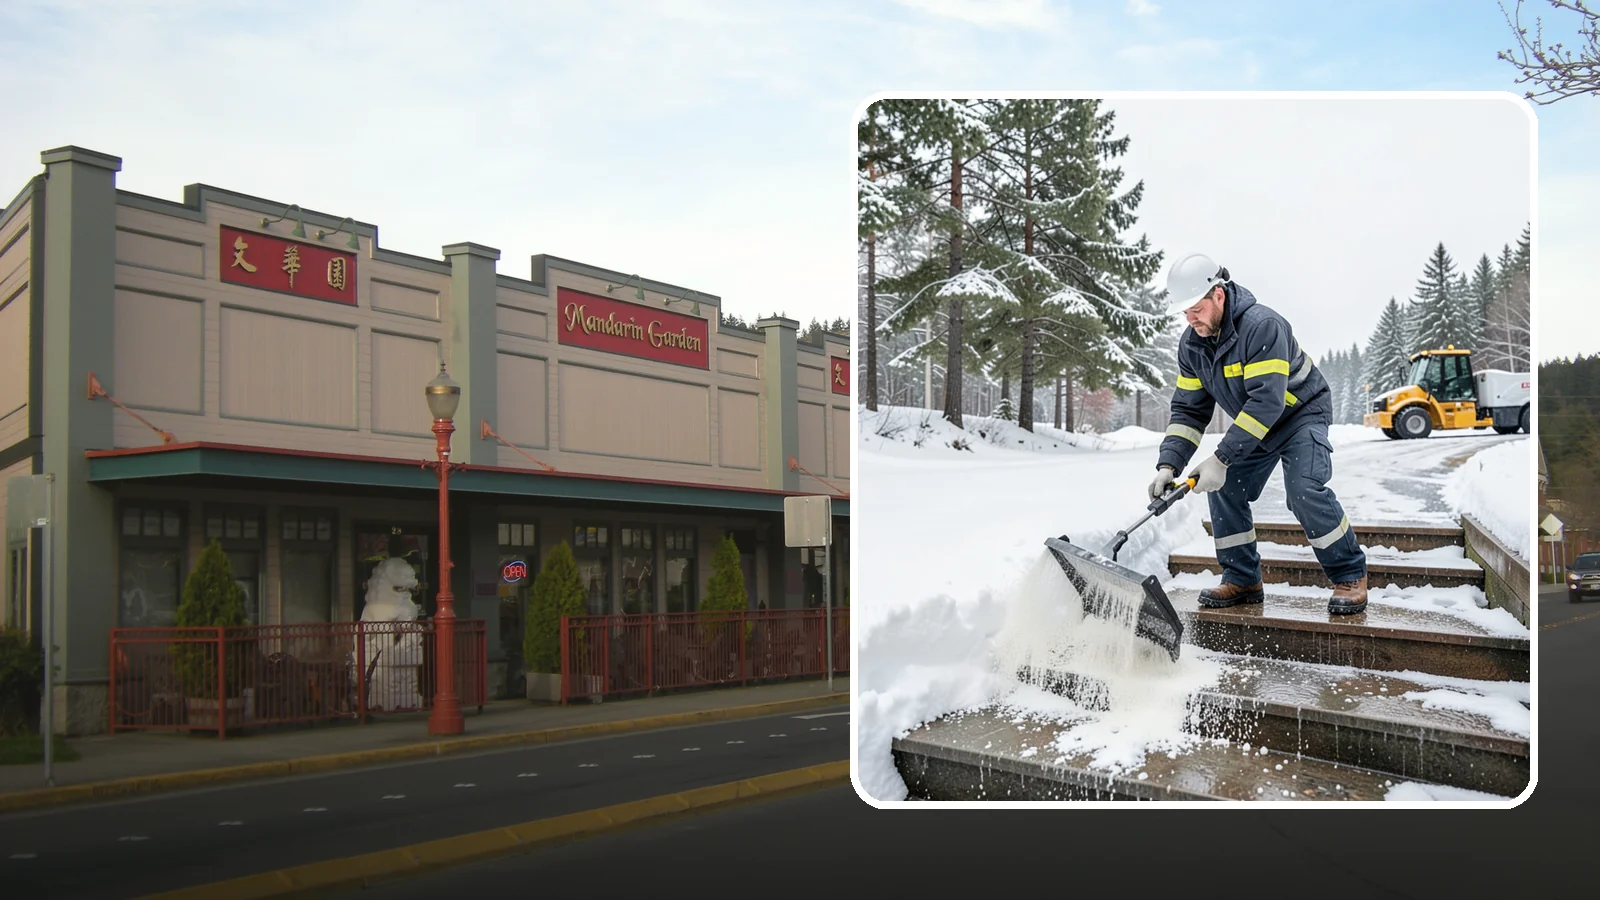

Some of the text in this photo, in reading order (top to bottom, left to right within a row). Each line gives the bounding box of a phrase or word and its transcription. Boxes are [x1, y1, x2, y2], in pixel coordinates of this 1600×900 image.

[231, 236, 346, 291] 文華園
[564, 302, 702, 352] Mandarin Garden
[503, 565, 527, 578] OPEN
